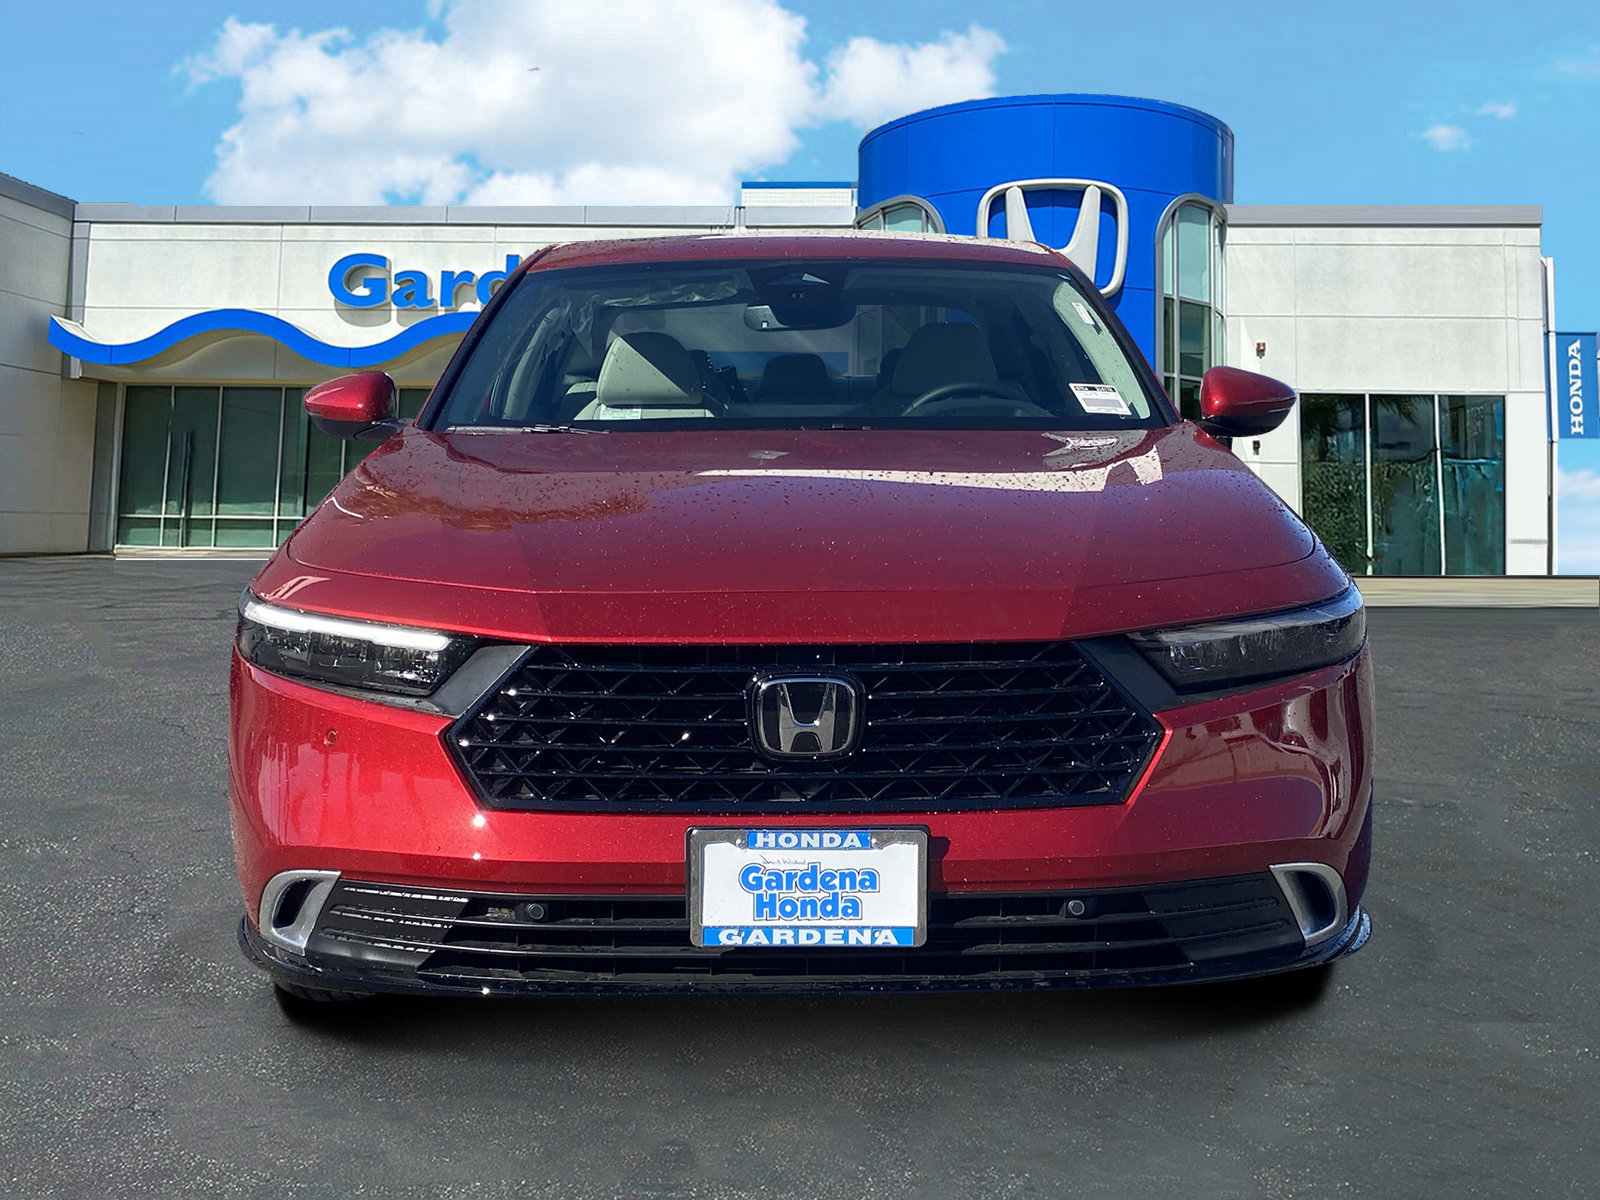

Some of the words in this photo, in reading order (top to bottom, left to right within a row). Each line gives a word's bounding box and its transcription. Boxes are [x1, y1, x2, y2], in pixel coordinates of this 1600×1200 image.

[1568, 339, 1584, 435] HONDA
[755, 832, 862, 848] HONDA
[740, 864, 878, 893] Gardena
[754, 892, 861, 919] Honda
[718, 928, 898, 946] GARDENA
